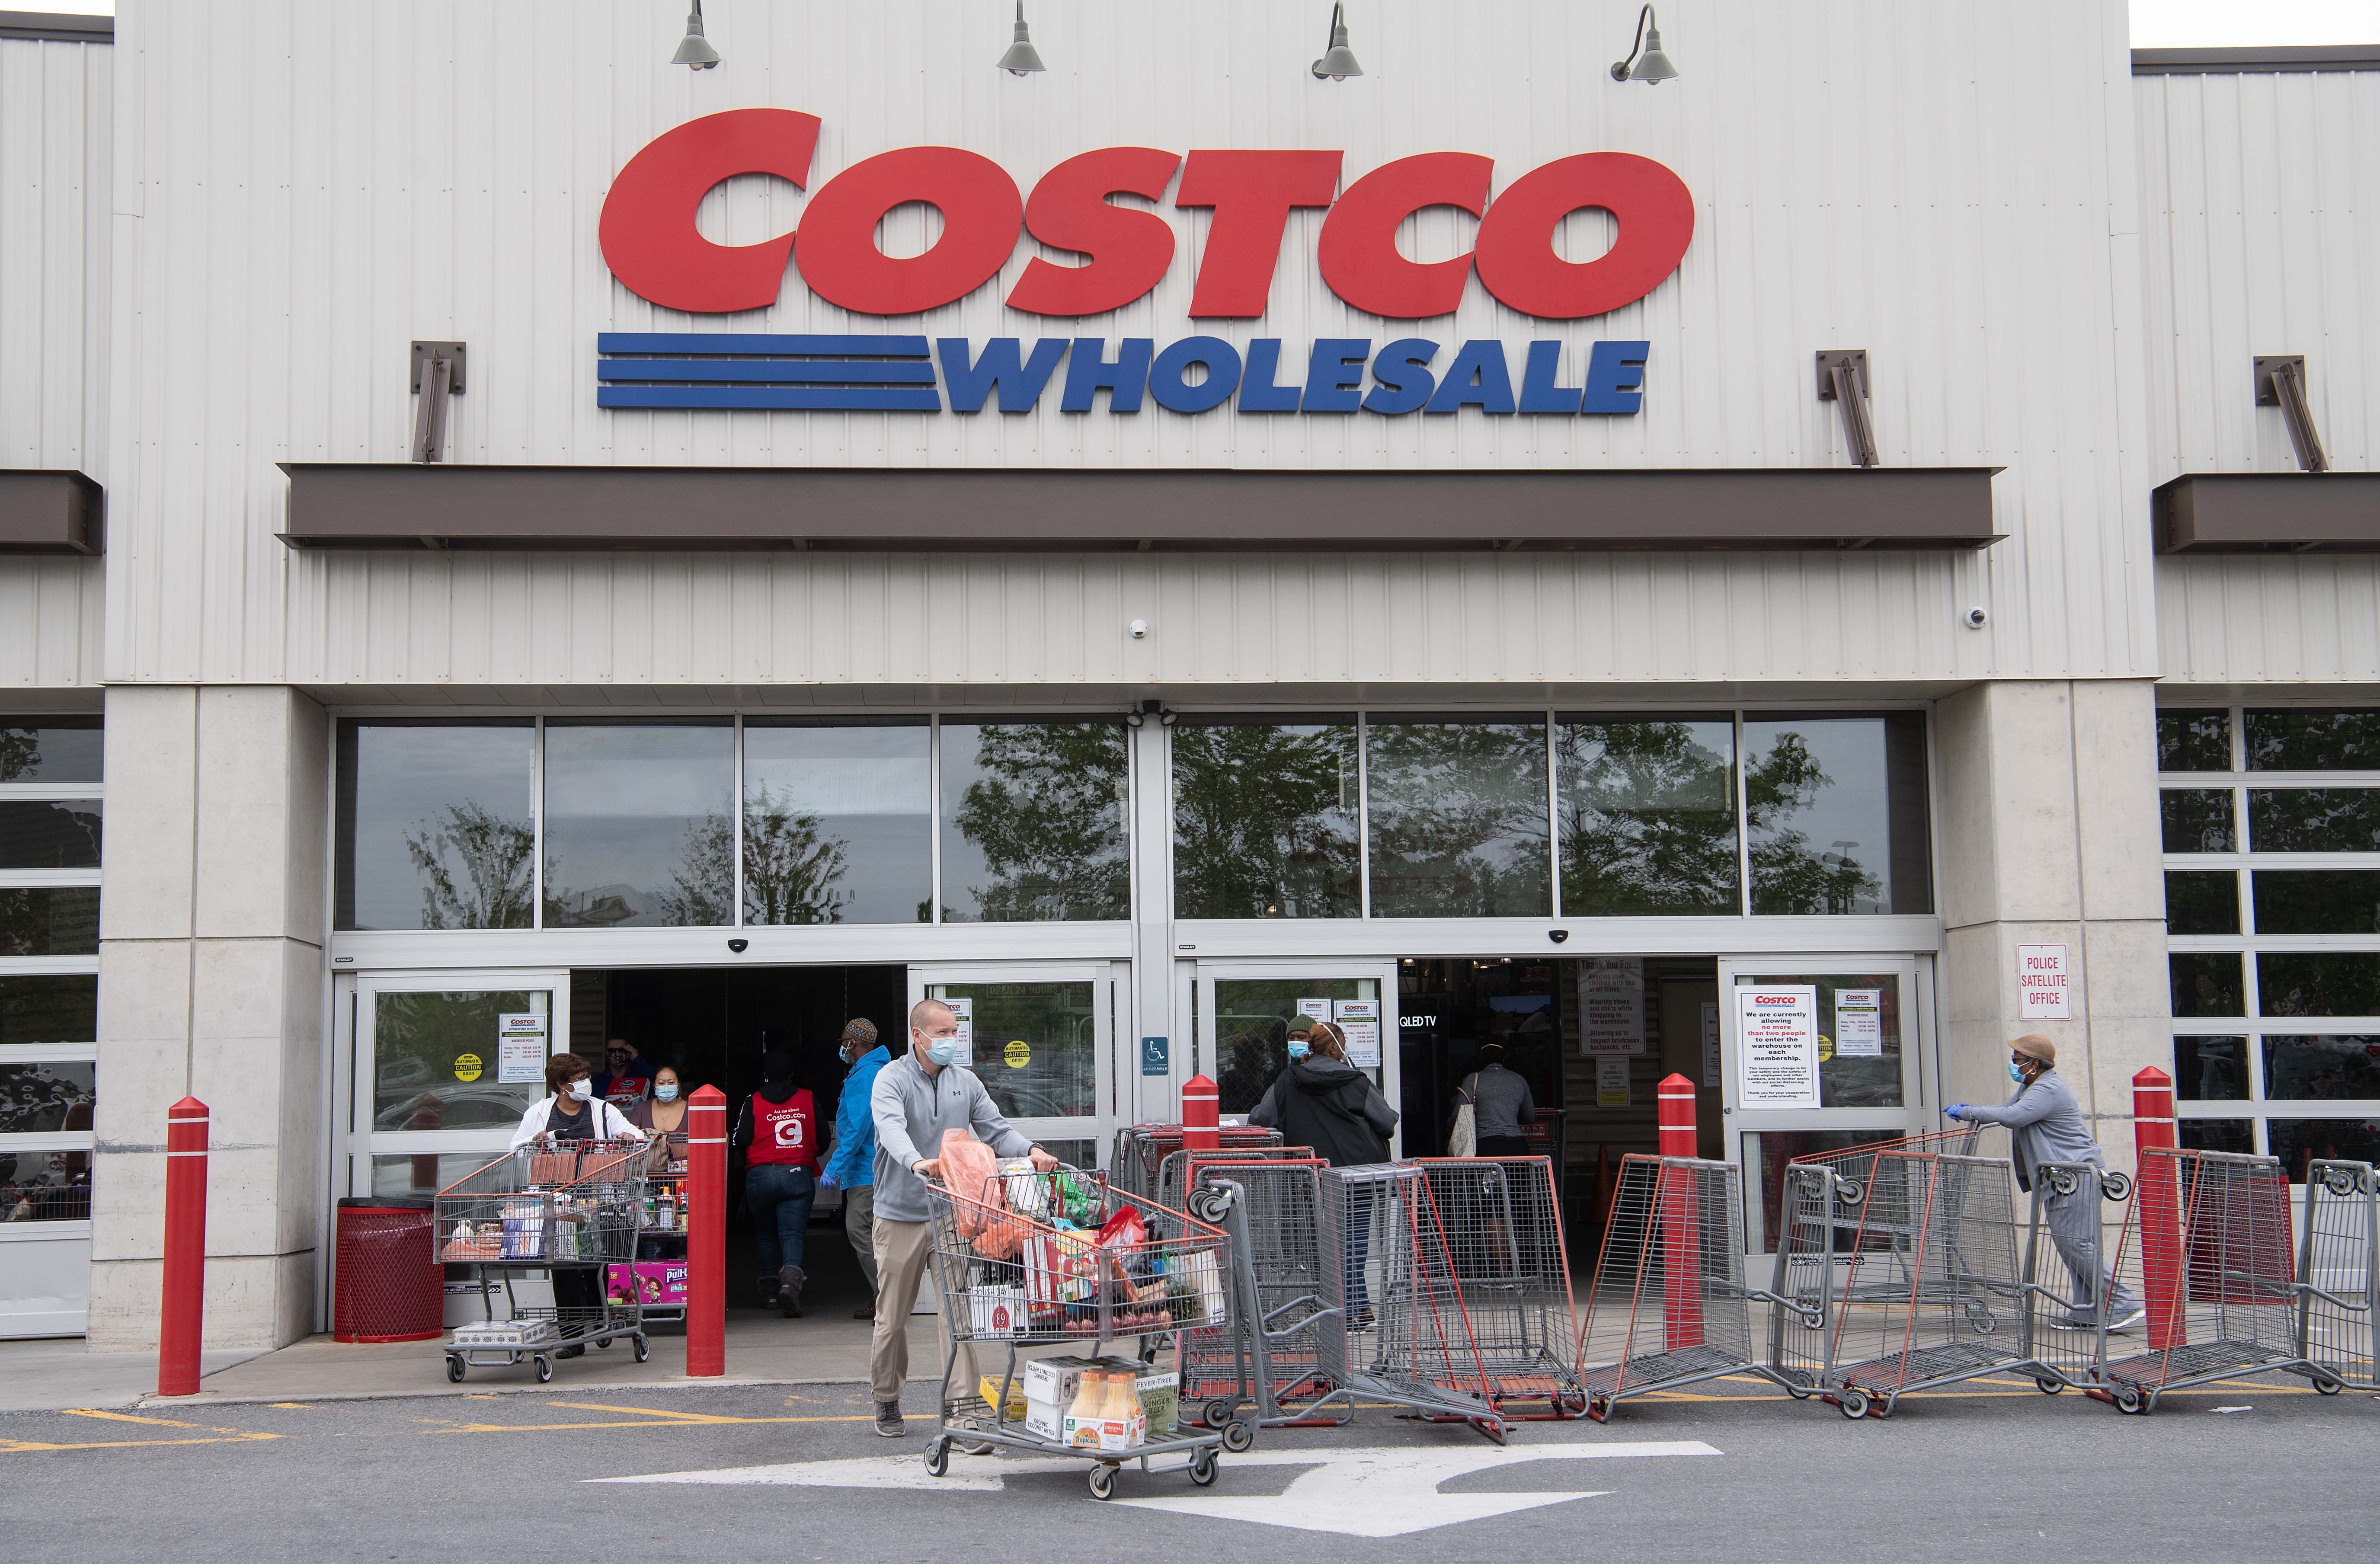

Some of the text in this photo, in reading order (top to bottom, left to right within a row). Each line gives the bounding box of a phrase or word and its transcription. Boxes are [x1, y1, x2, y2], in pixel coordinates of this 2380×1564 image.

[599, 109, 1695, 319] COSTCO
[936, 336, 1651, 415] WHOLESALE
[1582, 960, 1638, 969] Thank You For...
[2028, 957, 2058, 969] POLICE
[2022, 975, 2066, 986] SATELLITE
[990, 984, 1086, 995] OPEN 24 HOURS DAY
[1756, 996, 1796, 1004] COSTCO
[2030, 993, 2060, 1004] OFFICE
[1400, 1016, 1436, 1027] QLED TV
[779, 1123, 796, 1140] C
[997, 1288, 1007, 1296] DAY
[996, 1313, 1005, 1324] 89
[1027, 1364, 1055, 1378] COCONUT WATER
[1034, 1372, 1049, 1382] ORGANIC
[1137, 1377, 1172, 1388] FEVER-TREE
[1144, 1398, 1170, 1407] GINGER
[1034, 1418, 1048, 1428] ORGANIC
[1028, 1422, 1055, 1436] COCONUT WATER
[1076, 1436, 1098, 1444] Tropicana
